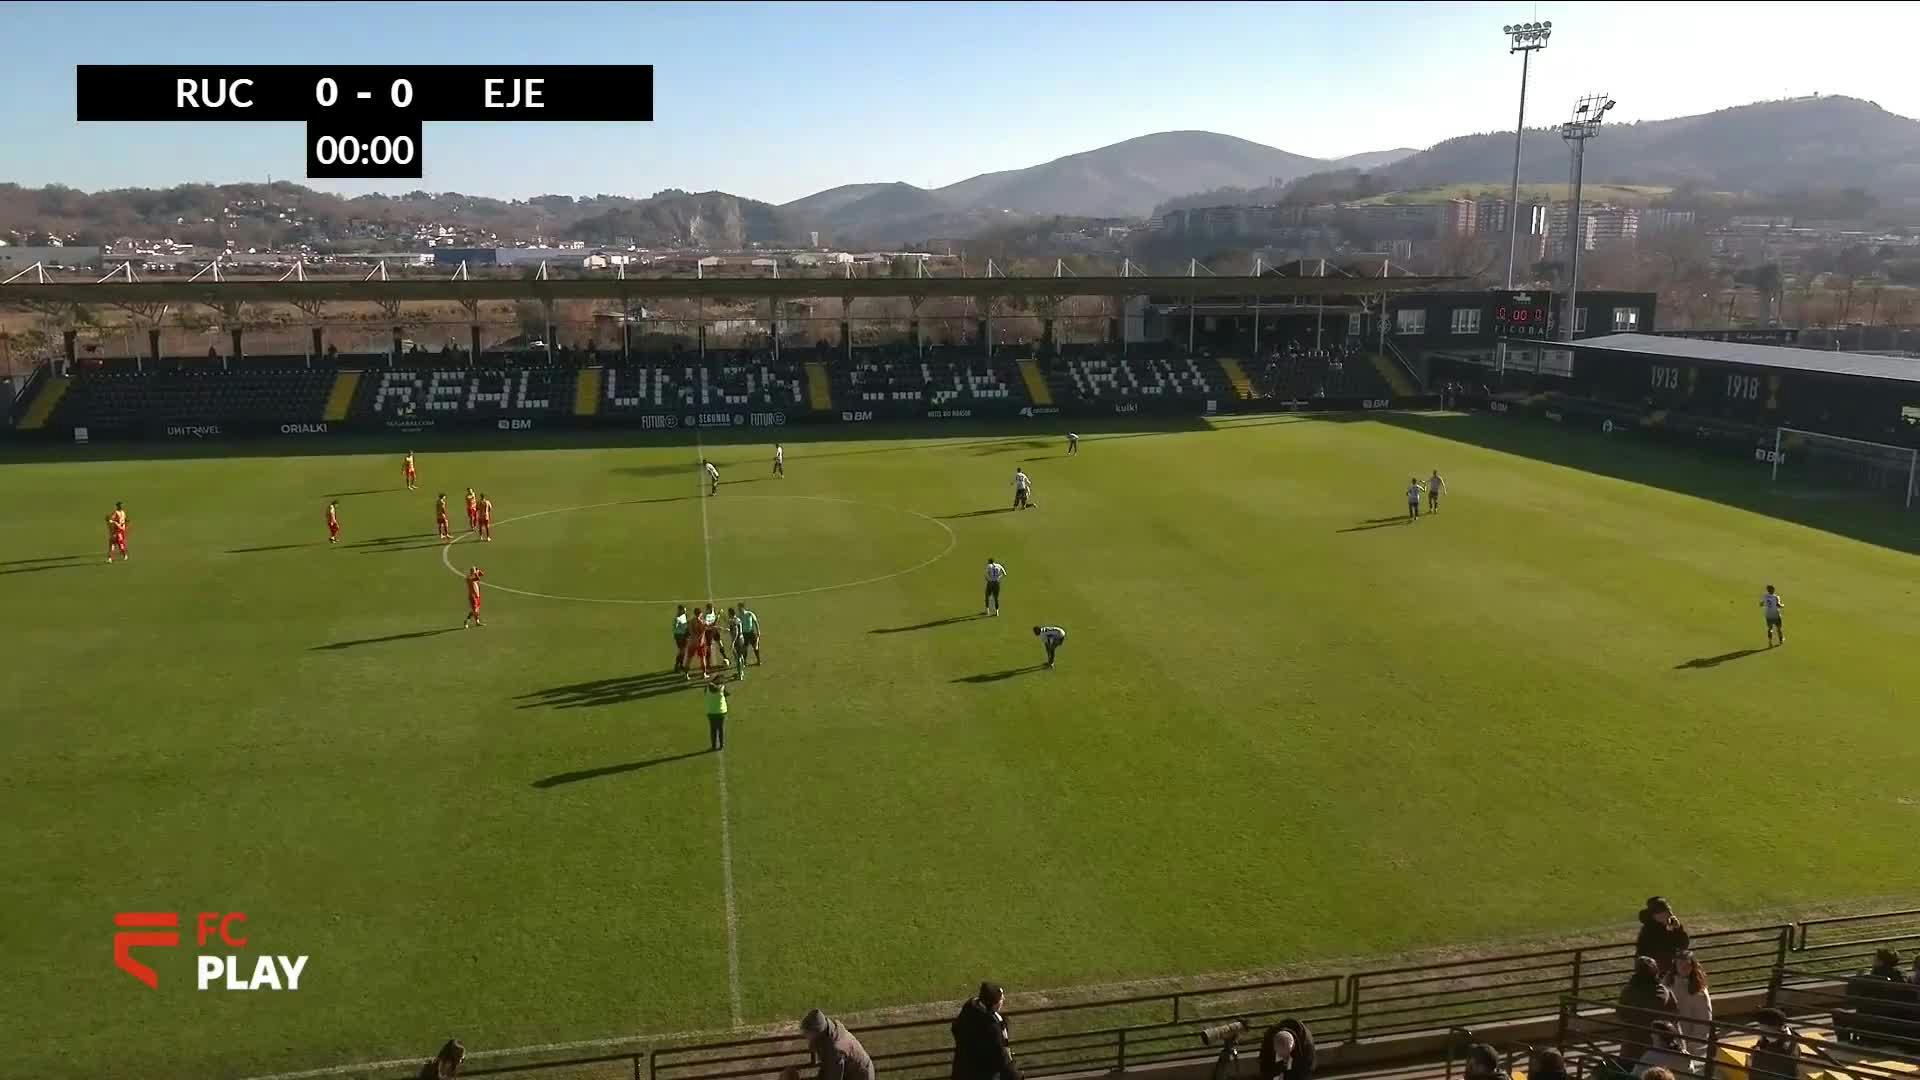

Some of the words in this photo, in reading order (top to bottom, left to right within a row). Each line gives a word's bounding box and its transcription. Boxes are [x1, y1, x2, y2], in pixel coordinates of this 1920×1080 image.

[1650, 366, 1681, 391] 1913
[373, 370, 549, 410] REAL
[1727, 375, 1760, 401] 1918
[511, 419, 532, 430] BM
[854, 411, 873, 422] BM
[280, 423, 328, 434] ORIALKI
